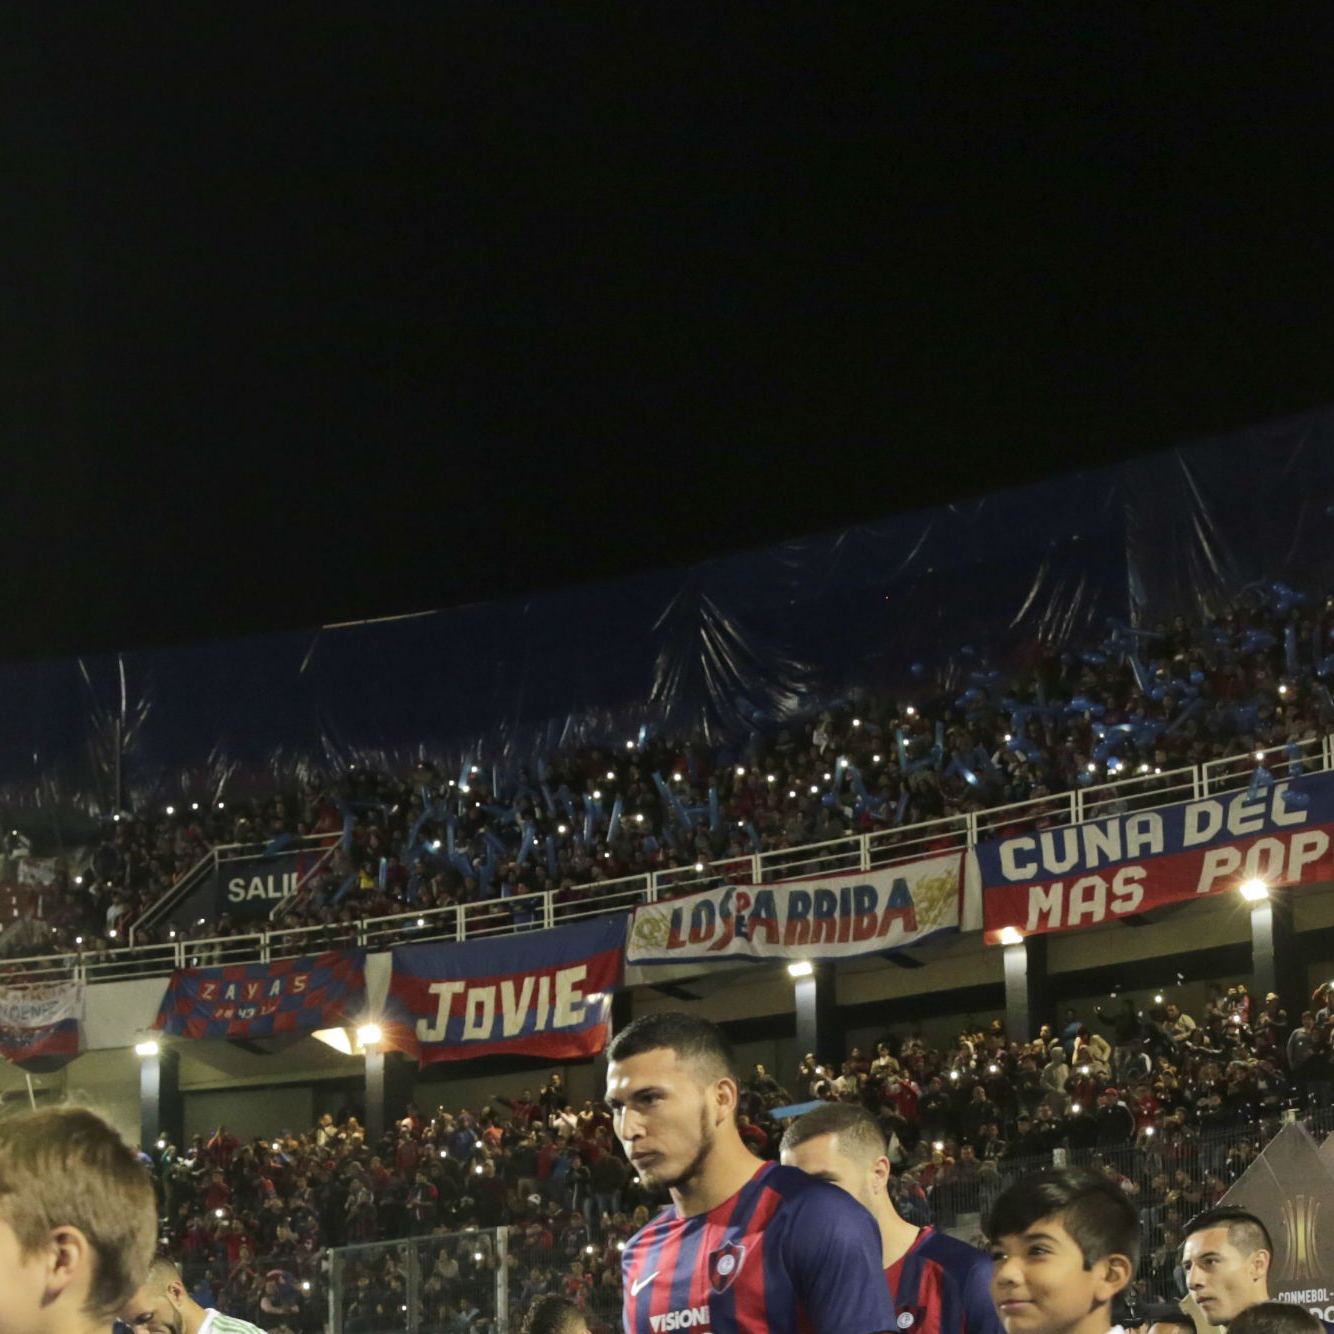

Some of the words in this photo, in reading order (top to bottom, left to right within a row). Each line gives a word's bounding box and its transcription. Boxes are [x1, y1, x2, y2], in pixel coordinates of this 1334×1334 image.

[999, 812, 1164, 881] CUNA
[1183, 785, 1308, 848] DEL
[748, 878, 918, 946] ARRIBA
[1026, 866, 1148, 931] MAS
